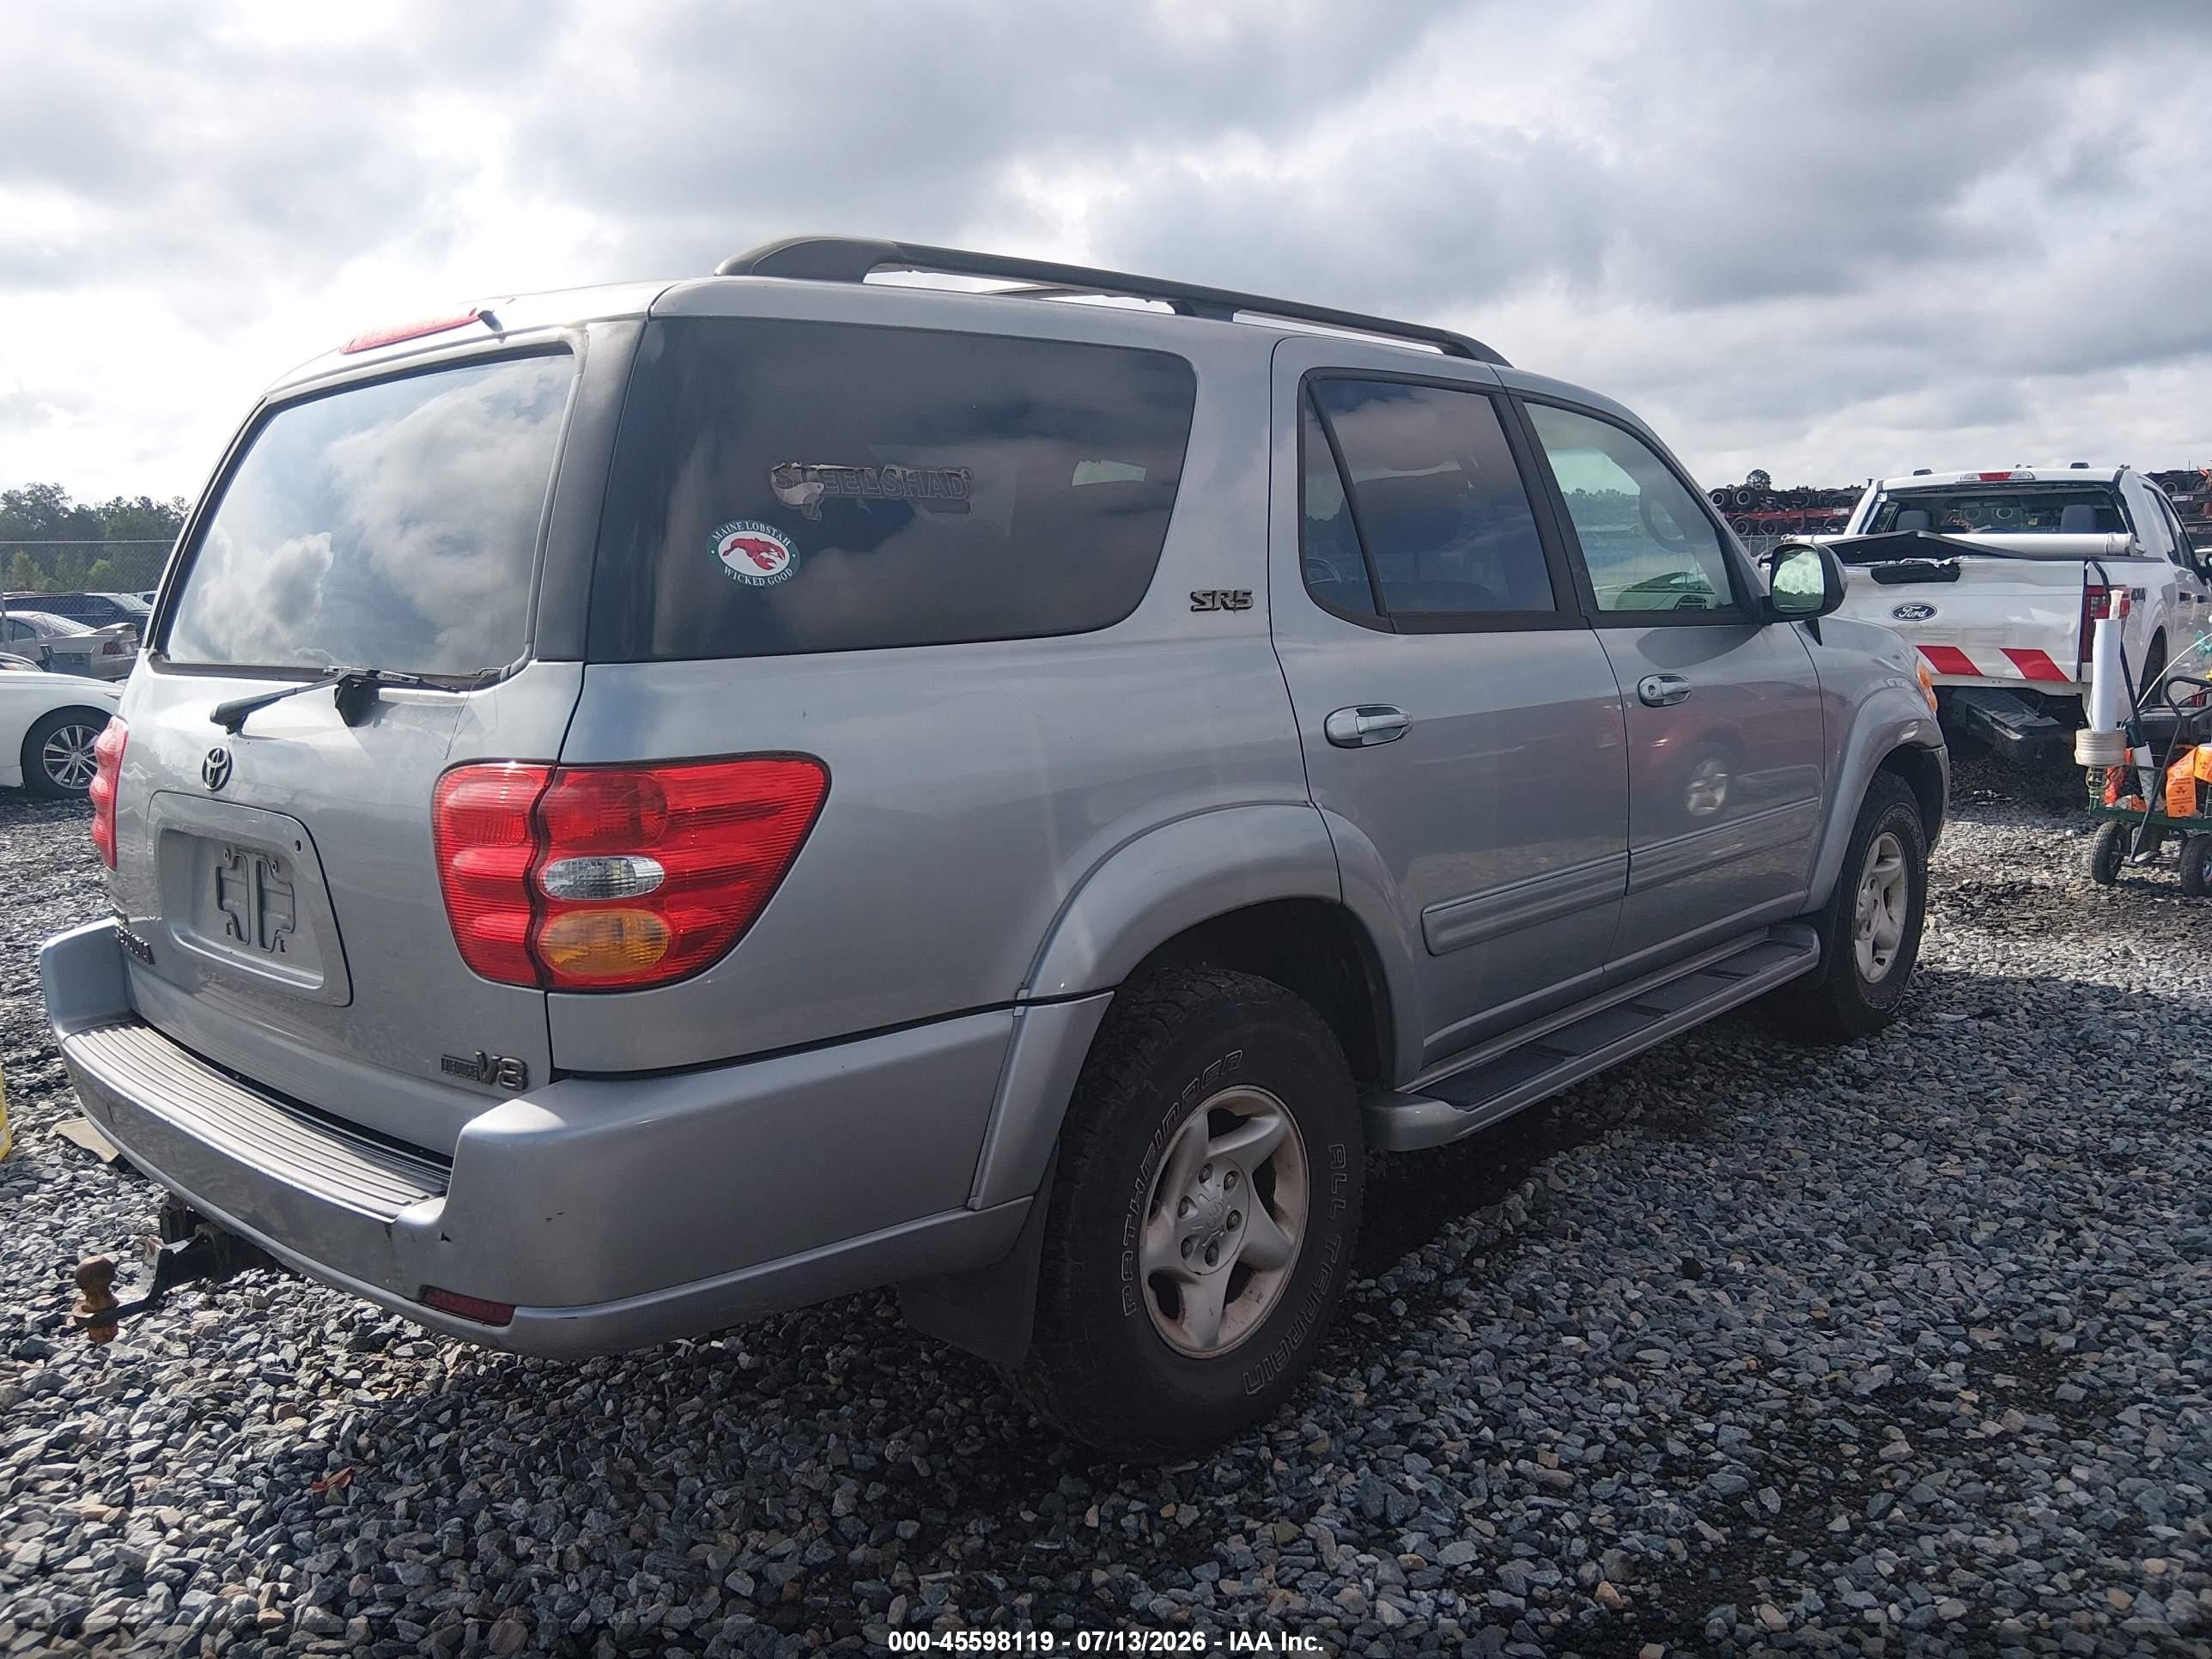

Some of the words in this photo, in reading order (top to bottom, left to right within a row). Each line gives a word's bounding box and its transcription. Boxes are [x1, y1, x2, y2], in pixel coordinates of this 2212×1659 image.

[711, 521, 744, 543] MAINE
[745, 521, 791, 547] LOBSTAH
[723, 566, 765, 586] WICKED
[767, 568, 793, 586] GOOD
[1190, 589, 1254, 611] SR5
[1897, 605, 1929, 618] Ford
[474, 1050, 528, 1091] V8
[1120, 1048, 1244, 1317] PATHFINDER
[1327, 1142, 1347, 1220] ALL
[1242, 1236, 1341, 1395] TERRAIN
